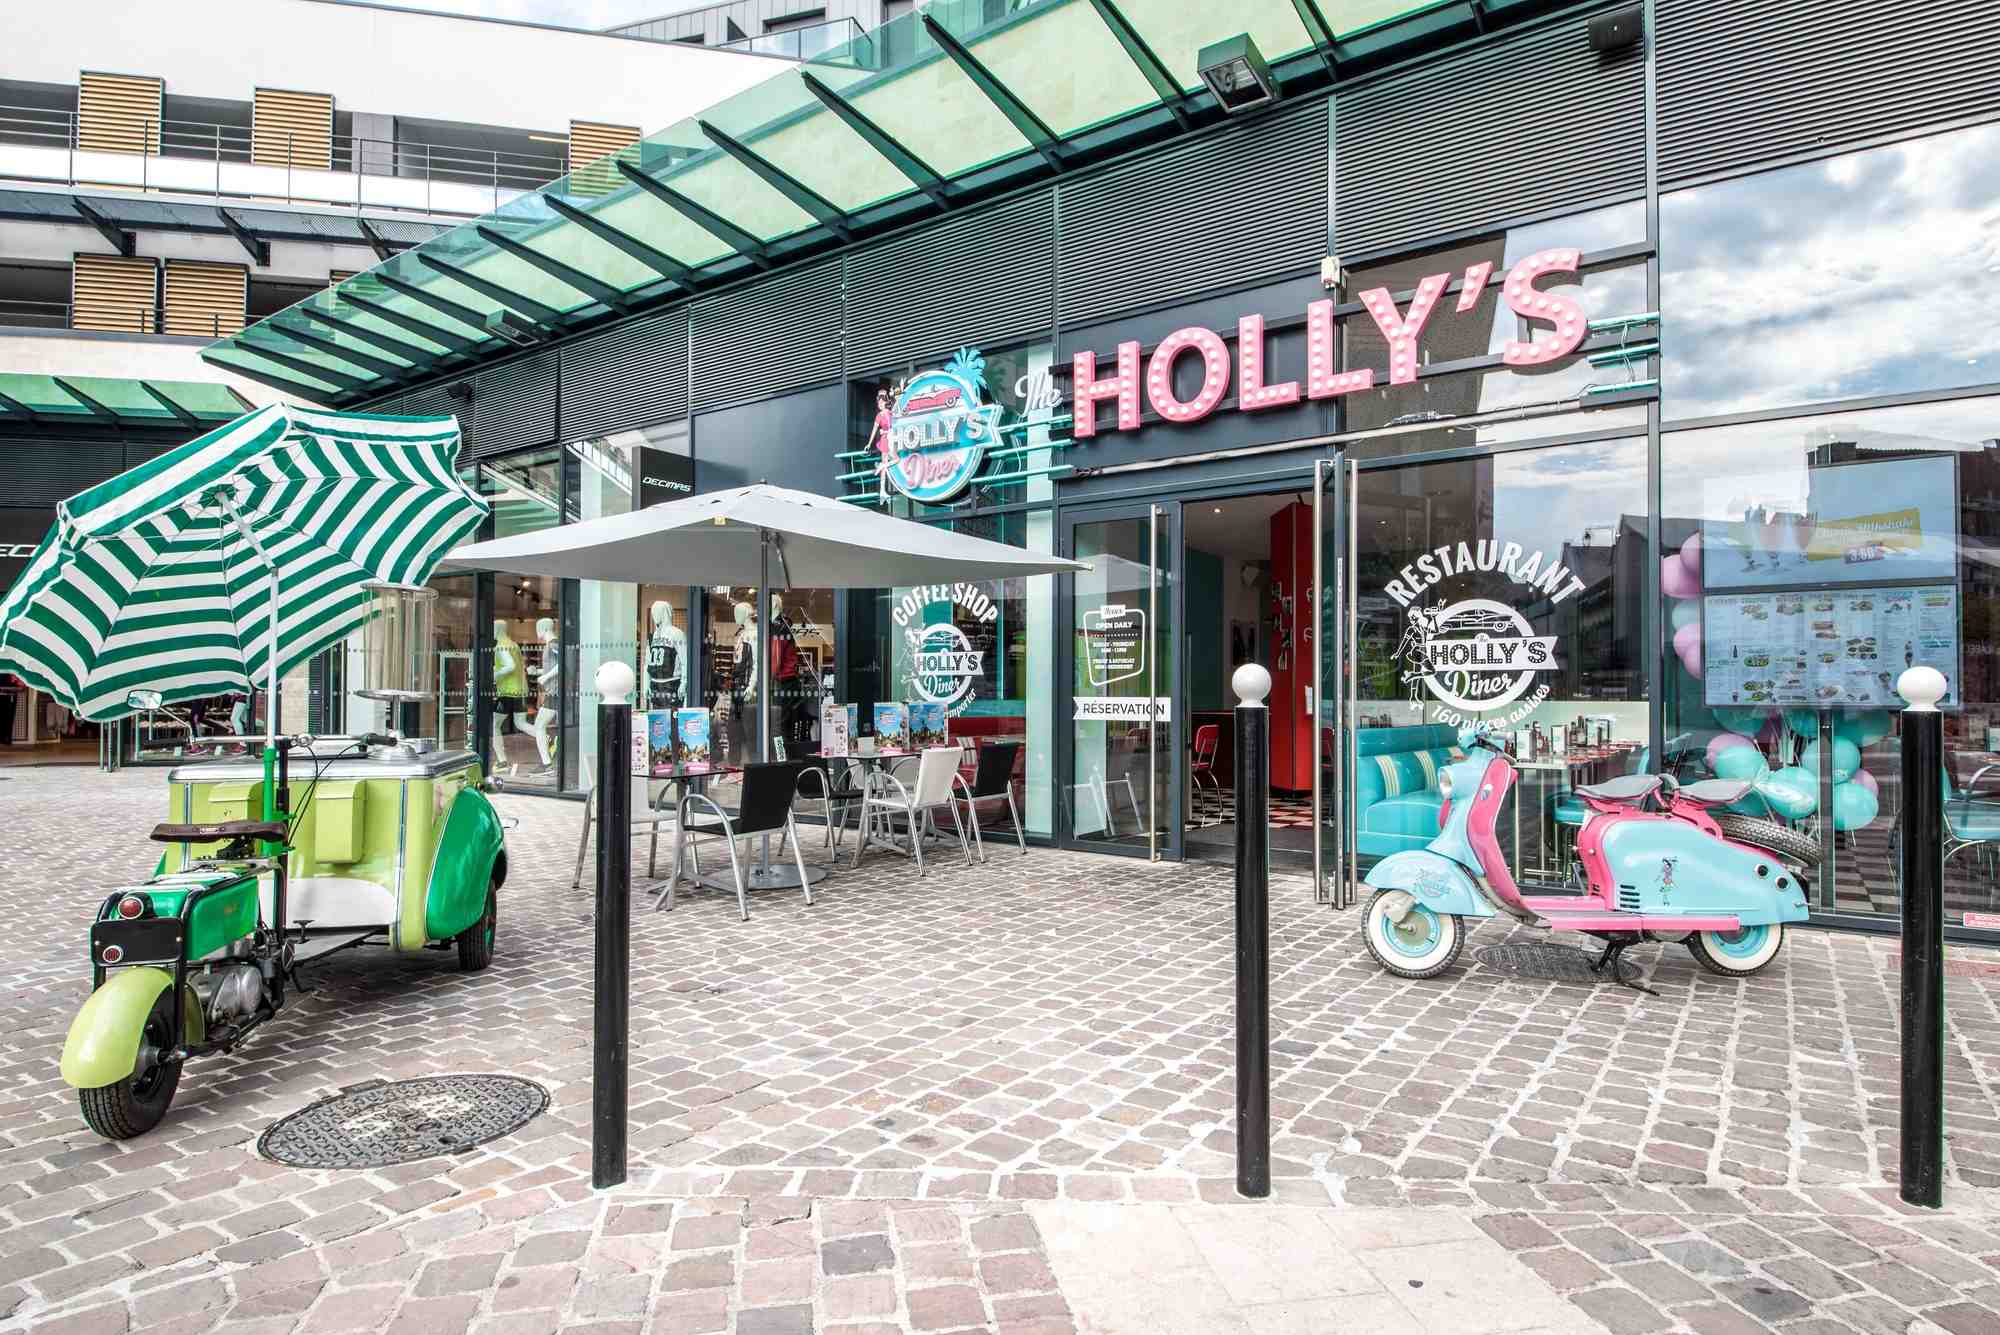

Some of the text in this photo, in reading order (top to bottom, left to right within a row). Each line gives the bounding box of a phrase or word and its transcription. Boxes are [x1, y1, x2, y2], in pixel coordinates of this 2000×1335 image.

[1014, 247, 1589, 437] The HOLLY'S
[888, 412, 983, 451] HOLLY'S
[642, 476, 691, 492] DECIMAS
[904, 453, 960, 489] Diner
[1384, 539, 1586, 608] RESTAURANT
[893, 582, 998, 626] COFFEE SHOP
[917, 653, 978, 672] HOLLY'S
[1430, 641, 1547, 666] HOLLY'S
[924, 673, 960, 696] Diner
[1444, 670, 1513, 699] Diner
[1431, 704, 1462, 728] 160
[1509, 683, 1551, 724] assises
